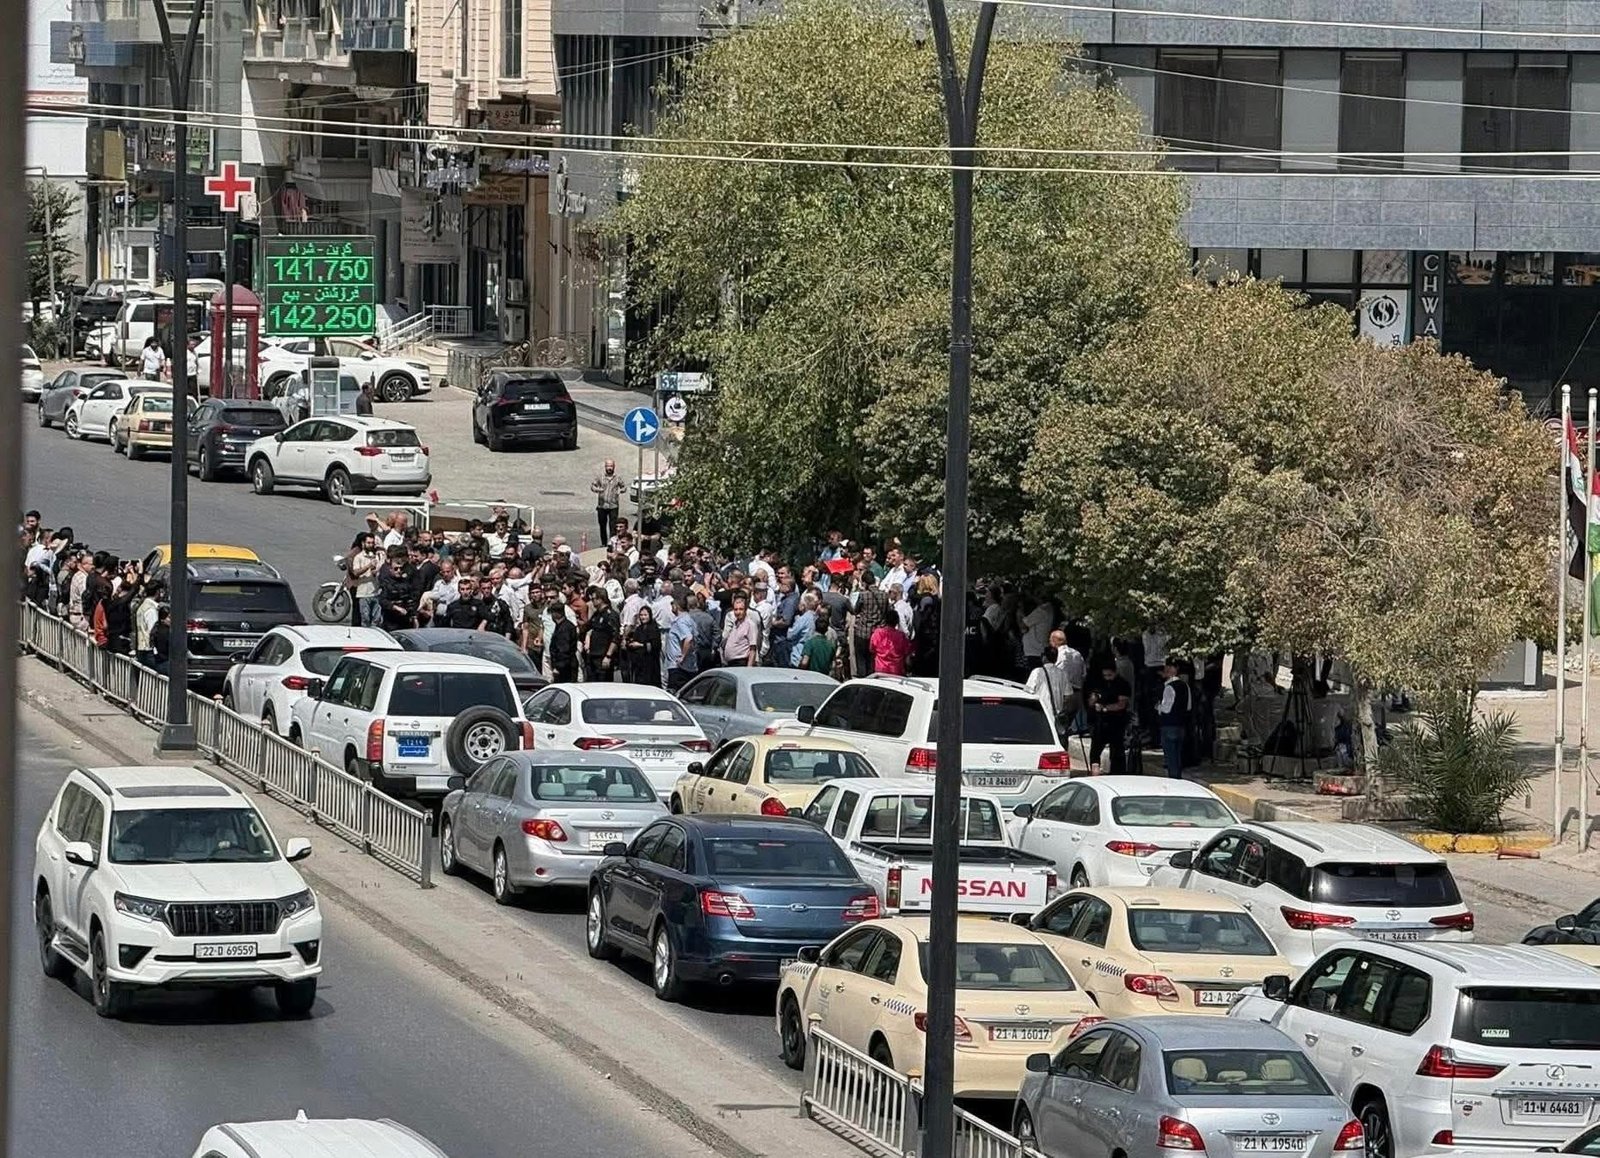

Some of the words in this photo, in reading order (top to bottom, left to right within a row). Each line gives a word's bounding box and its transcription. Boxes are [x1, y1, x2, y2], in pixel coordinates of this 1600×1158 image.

[270, 305, 372, 331] 142,250
[921, 878, 1026, 898] NSSAN
[226, 945, 254, 956] 69559
[1021, 1028, 1050, 1040] 16017
[1549, 1102, 1580, 1114] 64481
[1271, 1137, 1304, 1151] 19540
